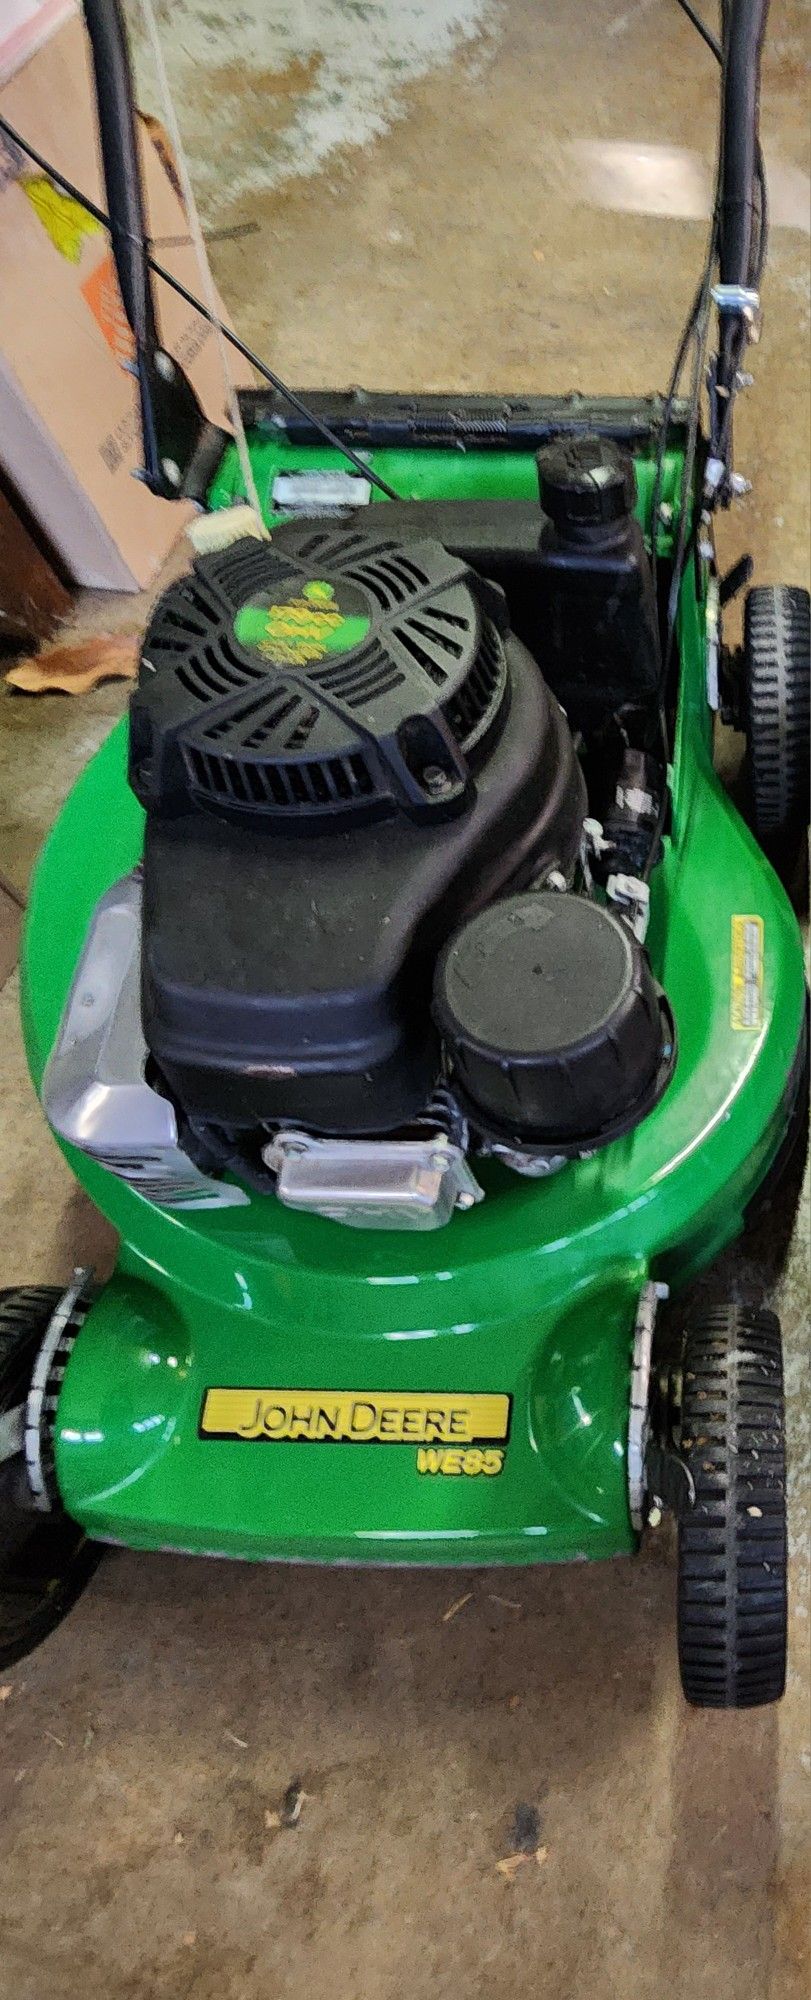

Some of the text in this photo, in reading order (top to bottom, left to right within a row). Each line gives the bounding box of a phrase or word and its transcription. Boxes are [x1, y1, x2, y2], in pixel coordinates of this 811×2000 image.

[239, 1398, 469, 1434] JOHN DEERE
[417, 1448, 504, 1475] WE85
